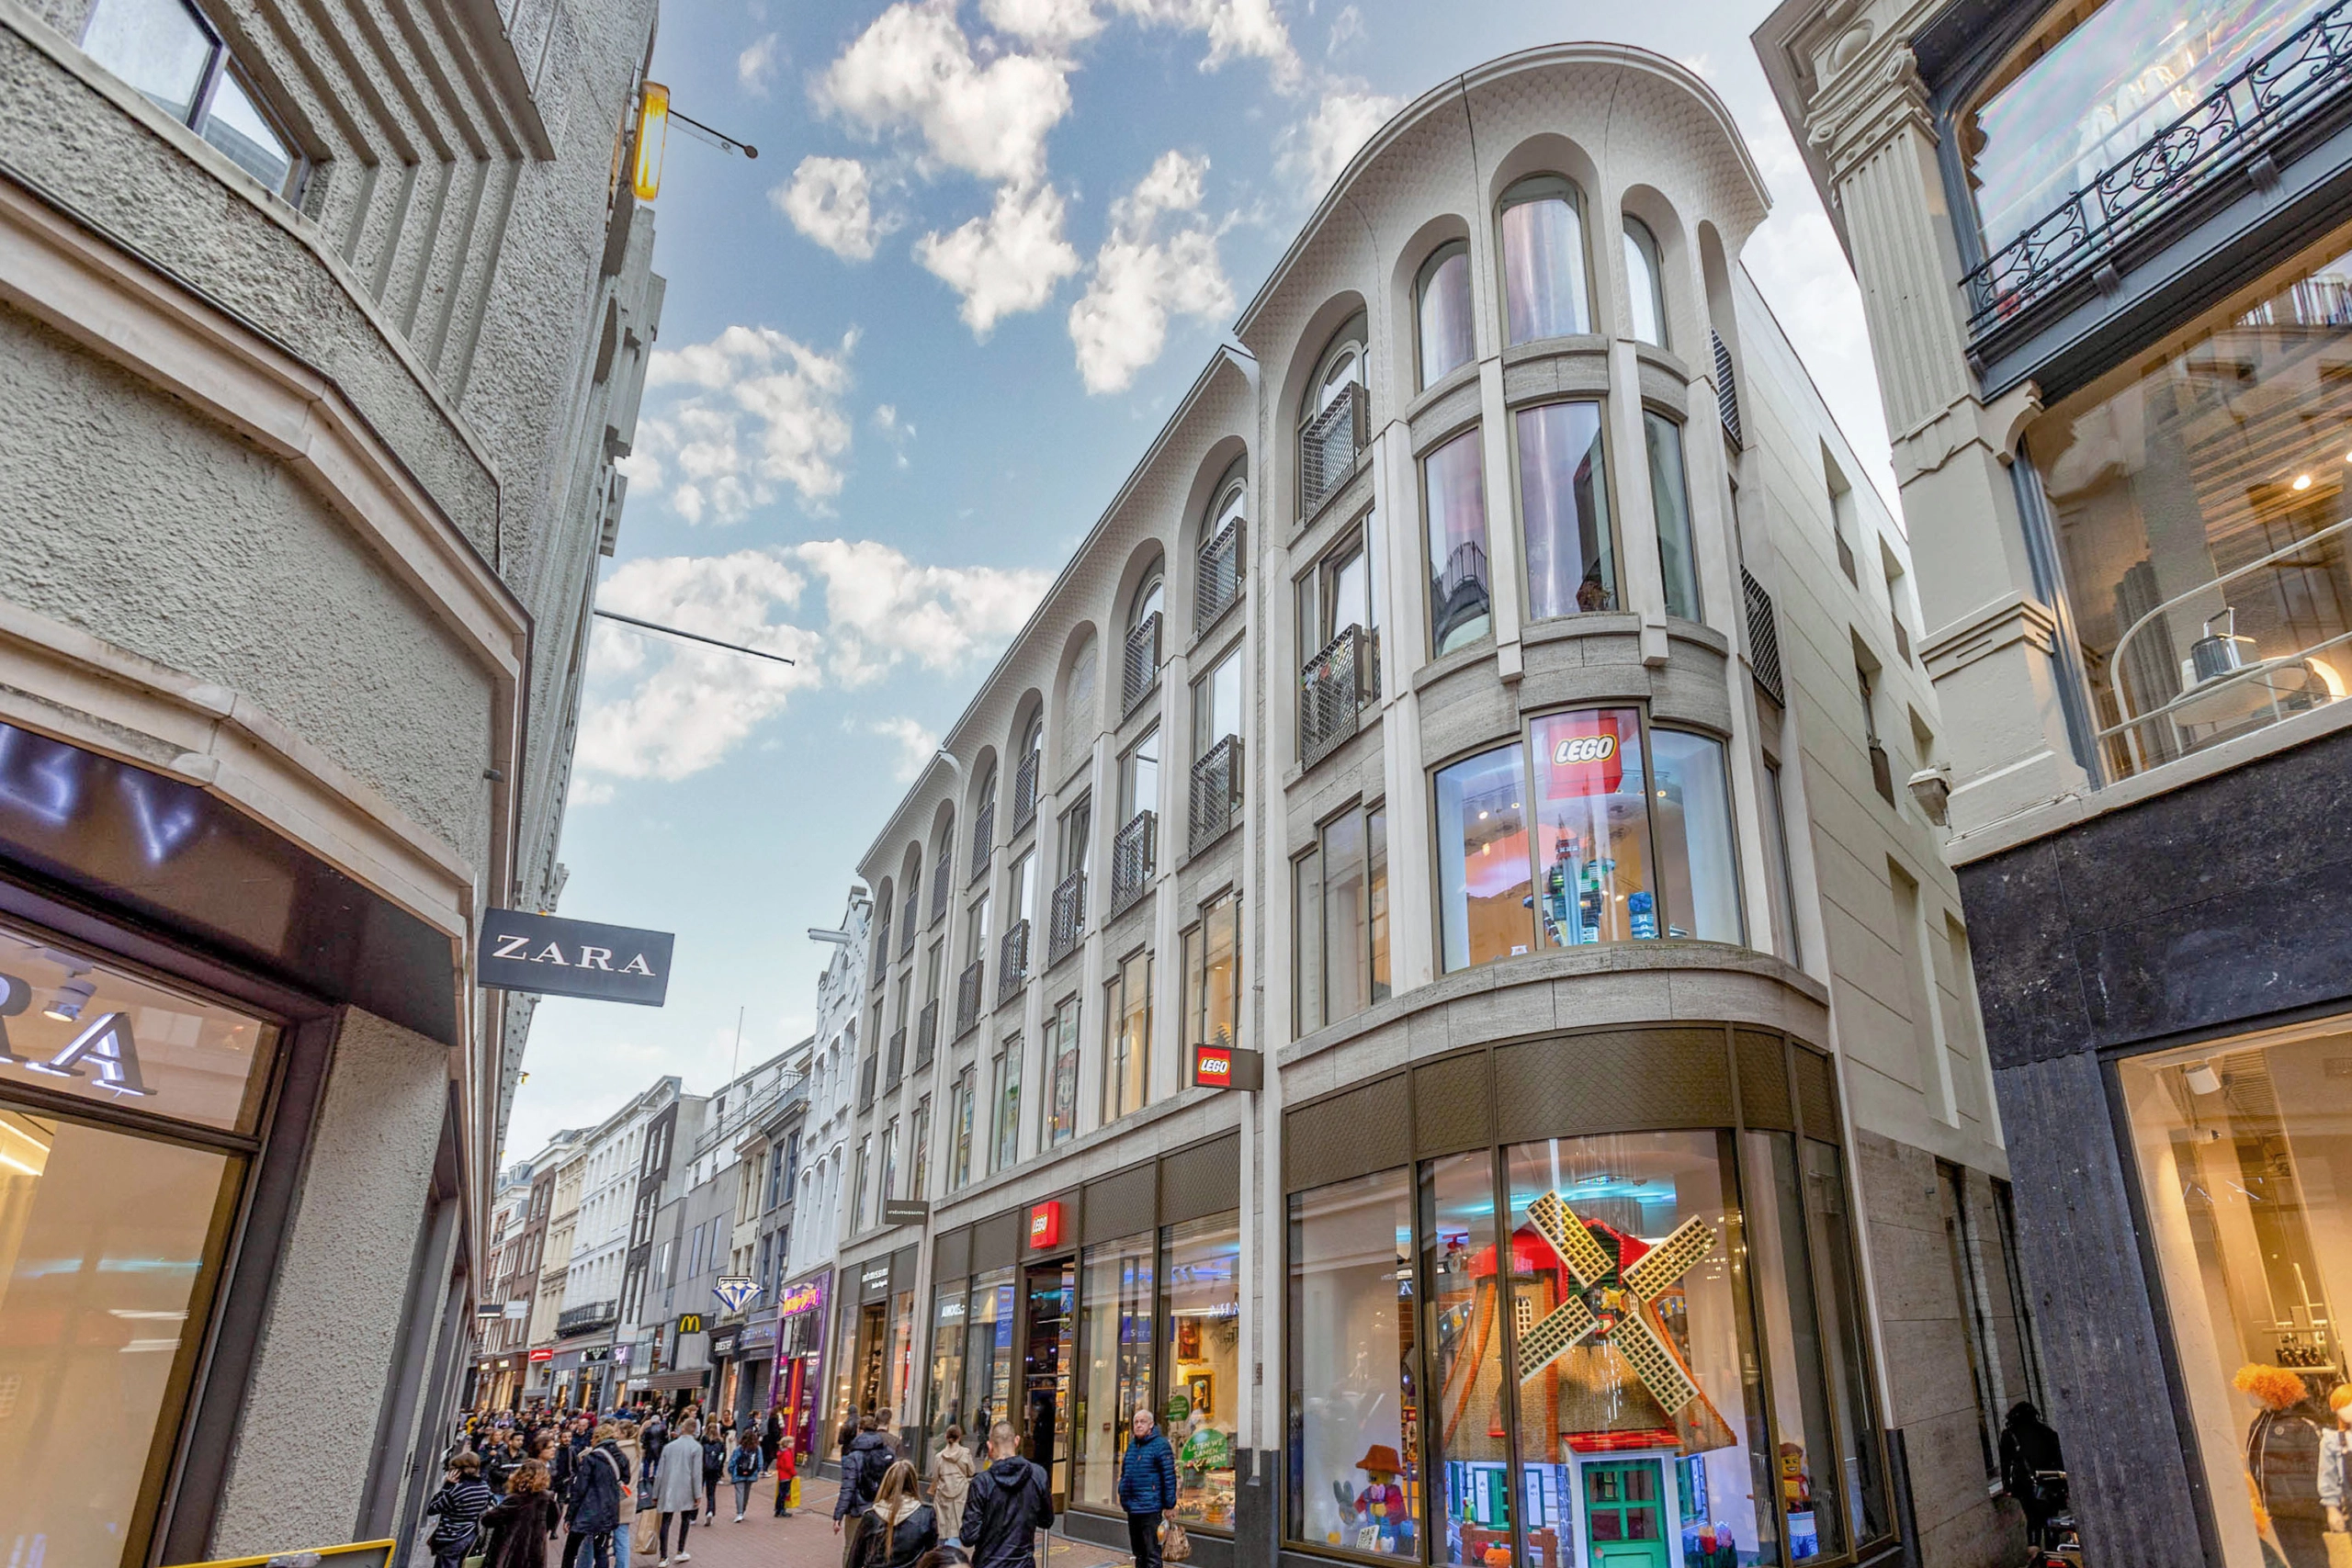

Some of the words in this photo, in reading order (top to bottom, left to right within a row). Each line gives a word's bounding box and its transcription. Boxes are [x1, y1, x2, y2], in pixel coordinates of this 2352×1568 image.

[1554, 734, 1616, 764] LEGO
[492, 934, 656, 976] ZARA
[1199, 1057, 1229, 1075] LEGO
[1032, 1213, 1048, 1235] LEGO
[1188, 1441, 1211, 1452] LATEN
[1212, 1438, 1223, 1447] WE
[1193, 1448, 1218, 1458] SAMEN
